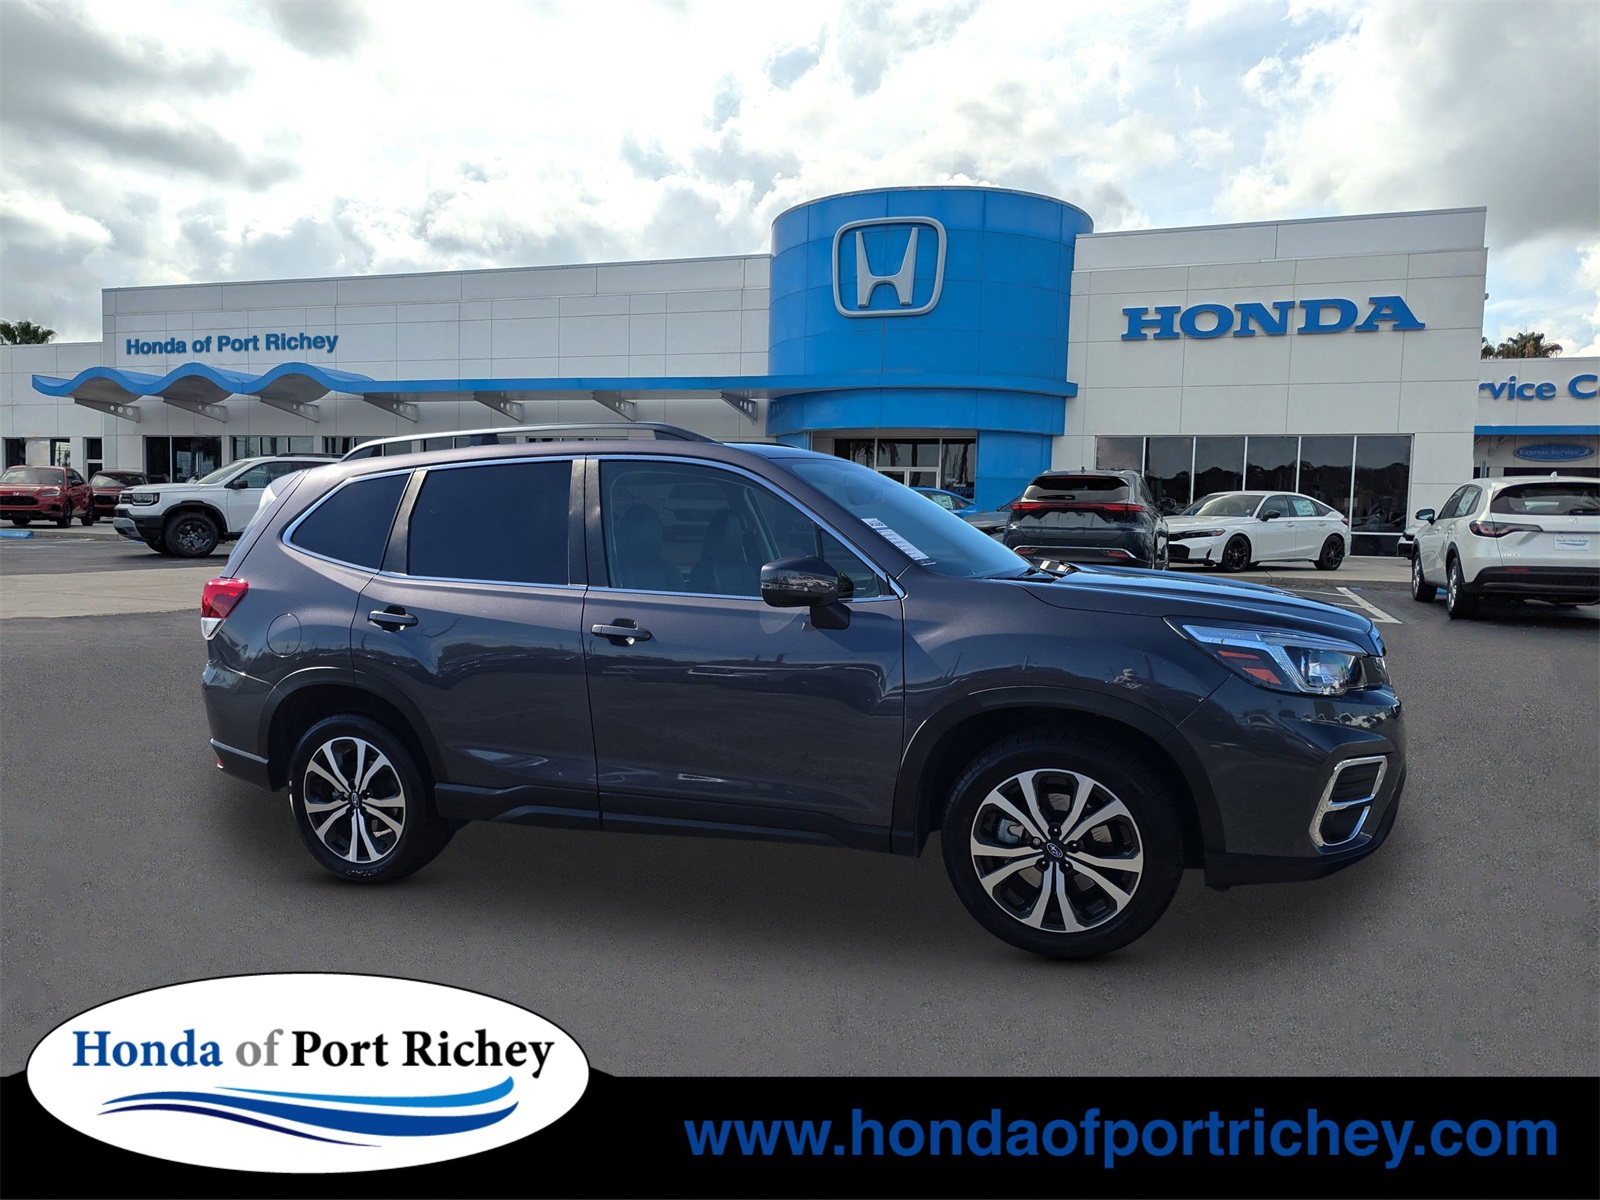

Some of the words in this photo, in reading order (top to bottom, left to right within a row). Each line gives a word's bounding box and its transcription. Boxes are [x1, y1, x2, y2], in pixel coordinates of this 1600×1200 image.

[1121, 295, 1426, 341] HONDA
[126, 336, 187, 355] Honda
[191, 335, 212, 354] of
[217, 335, 260, 353] Port
[265, 332, 339, 353] Richey
[1568, 374, 1600, 399] C
